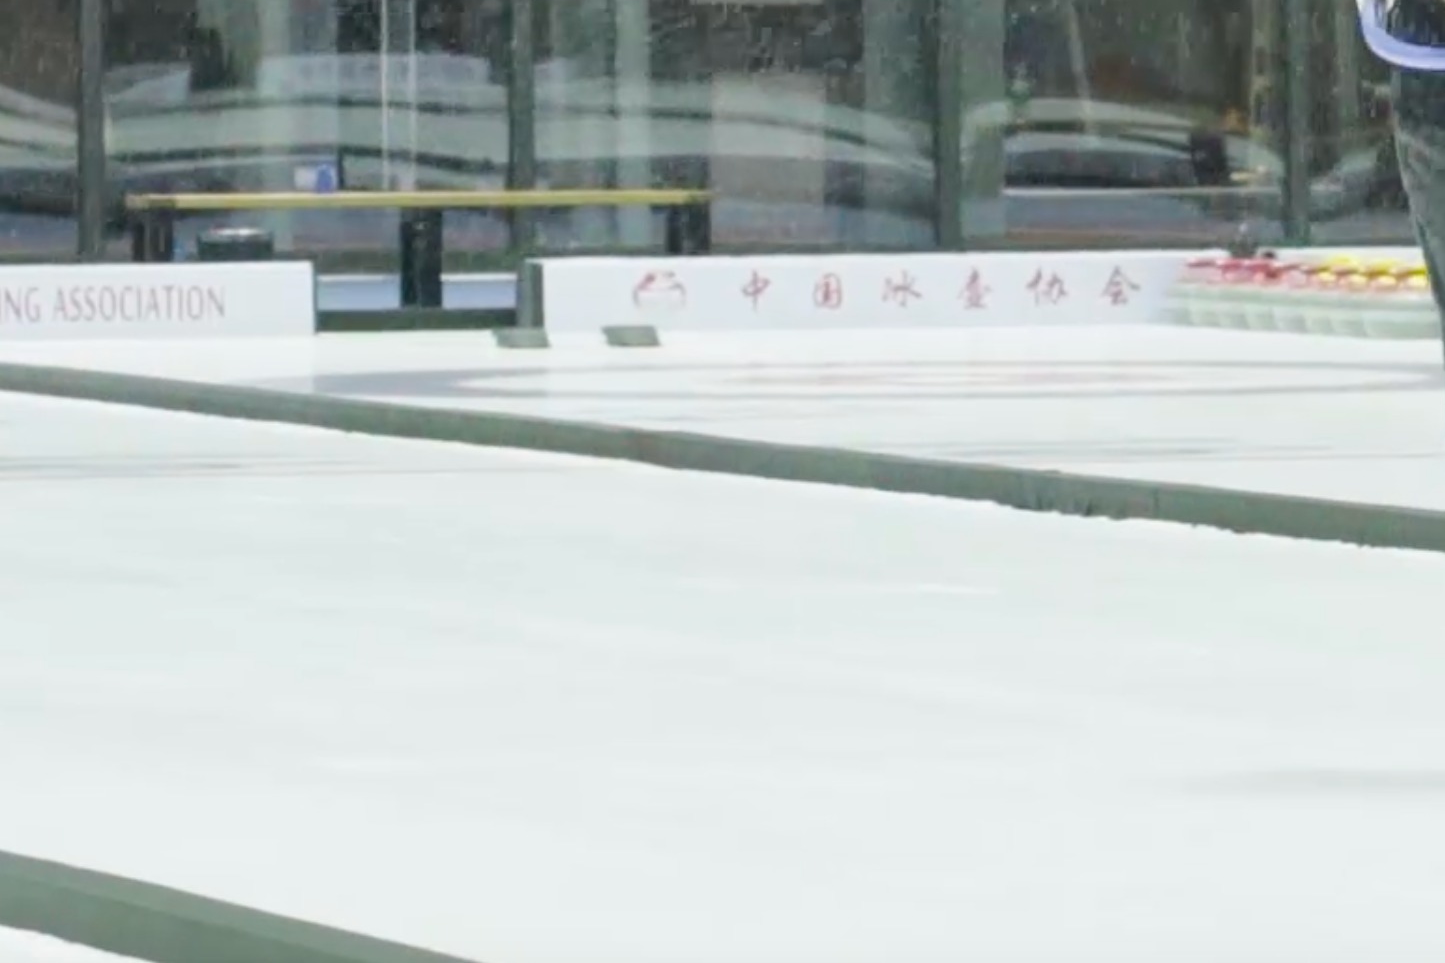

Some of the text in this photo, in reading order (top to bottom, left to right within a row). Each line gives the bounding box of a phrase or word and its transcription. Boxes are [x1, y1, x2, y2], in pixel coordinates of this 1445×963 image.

[0, 283, 226, 323] NG ASSOCIATION
[741, 264, 1142, 312] 中国冰壶协会
